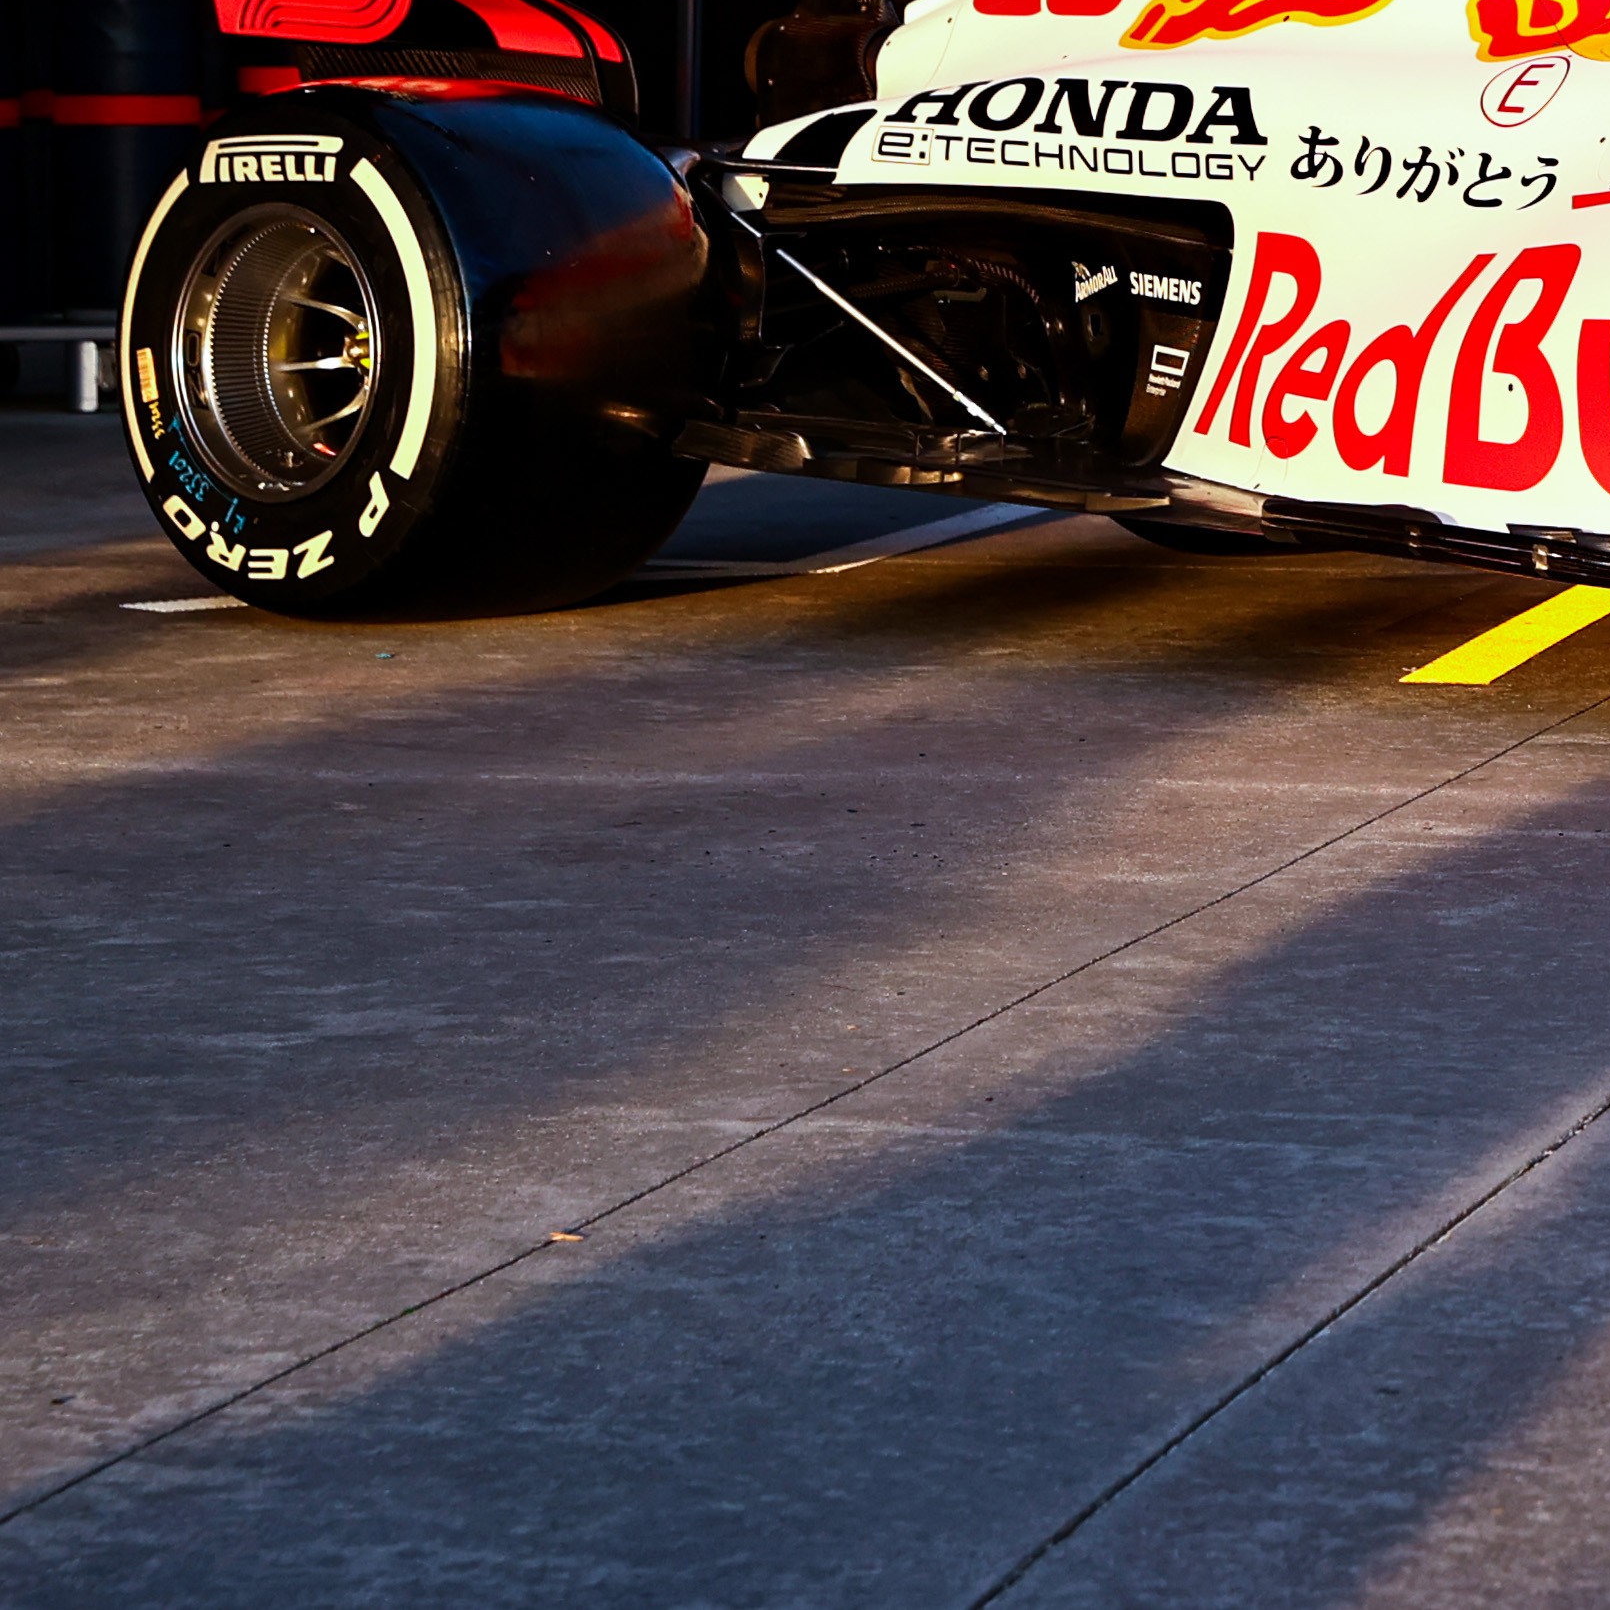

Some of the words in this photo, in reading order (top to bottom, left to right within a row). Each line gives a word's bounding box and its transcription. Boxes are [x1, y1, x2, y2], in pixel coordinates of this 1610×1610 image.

[884, 76, 1268, 146] HONDA
[1497, 63, 1555, 114] E
[199, 134, 344, 183] PIRELLI
[1290, 126, 1560, 211] ありがとう
[1129, 271, 1202, 306] SIEMENS
[1194, 230, 1497, 478] Red
[163, 495, 335, 580] ZERO
[358, 471, 391, 538] P
